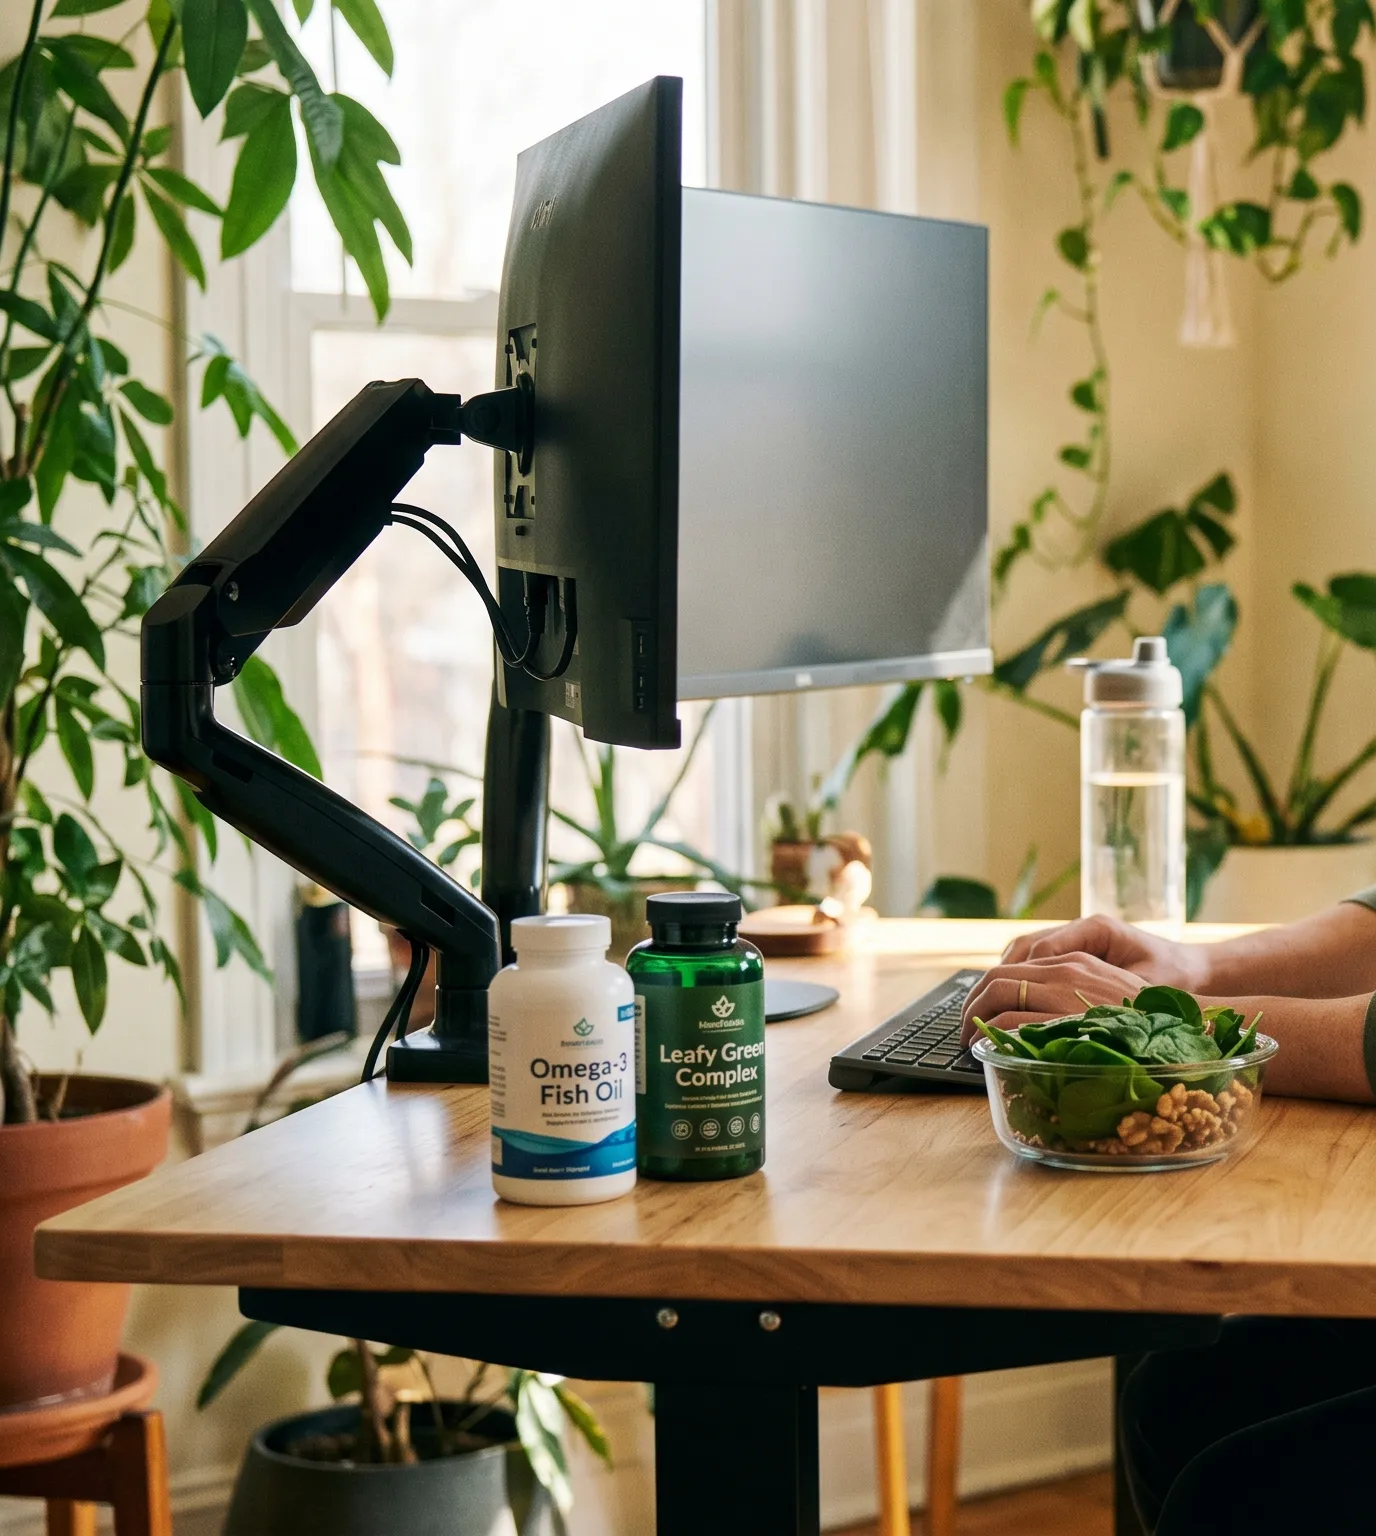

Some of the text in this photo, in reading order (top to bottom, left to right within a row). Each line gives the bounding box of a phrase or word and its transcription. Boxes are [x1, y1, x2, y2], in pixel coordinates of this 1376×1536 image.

[530, 1052, 627, 1081] Omega-3
[660, 1044, 717, 1067] Leafy
[675, 1065, 758, 1088] Complex
[541, 1079, 623, 1105] Fish Oil
